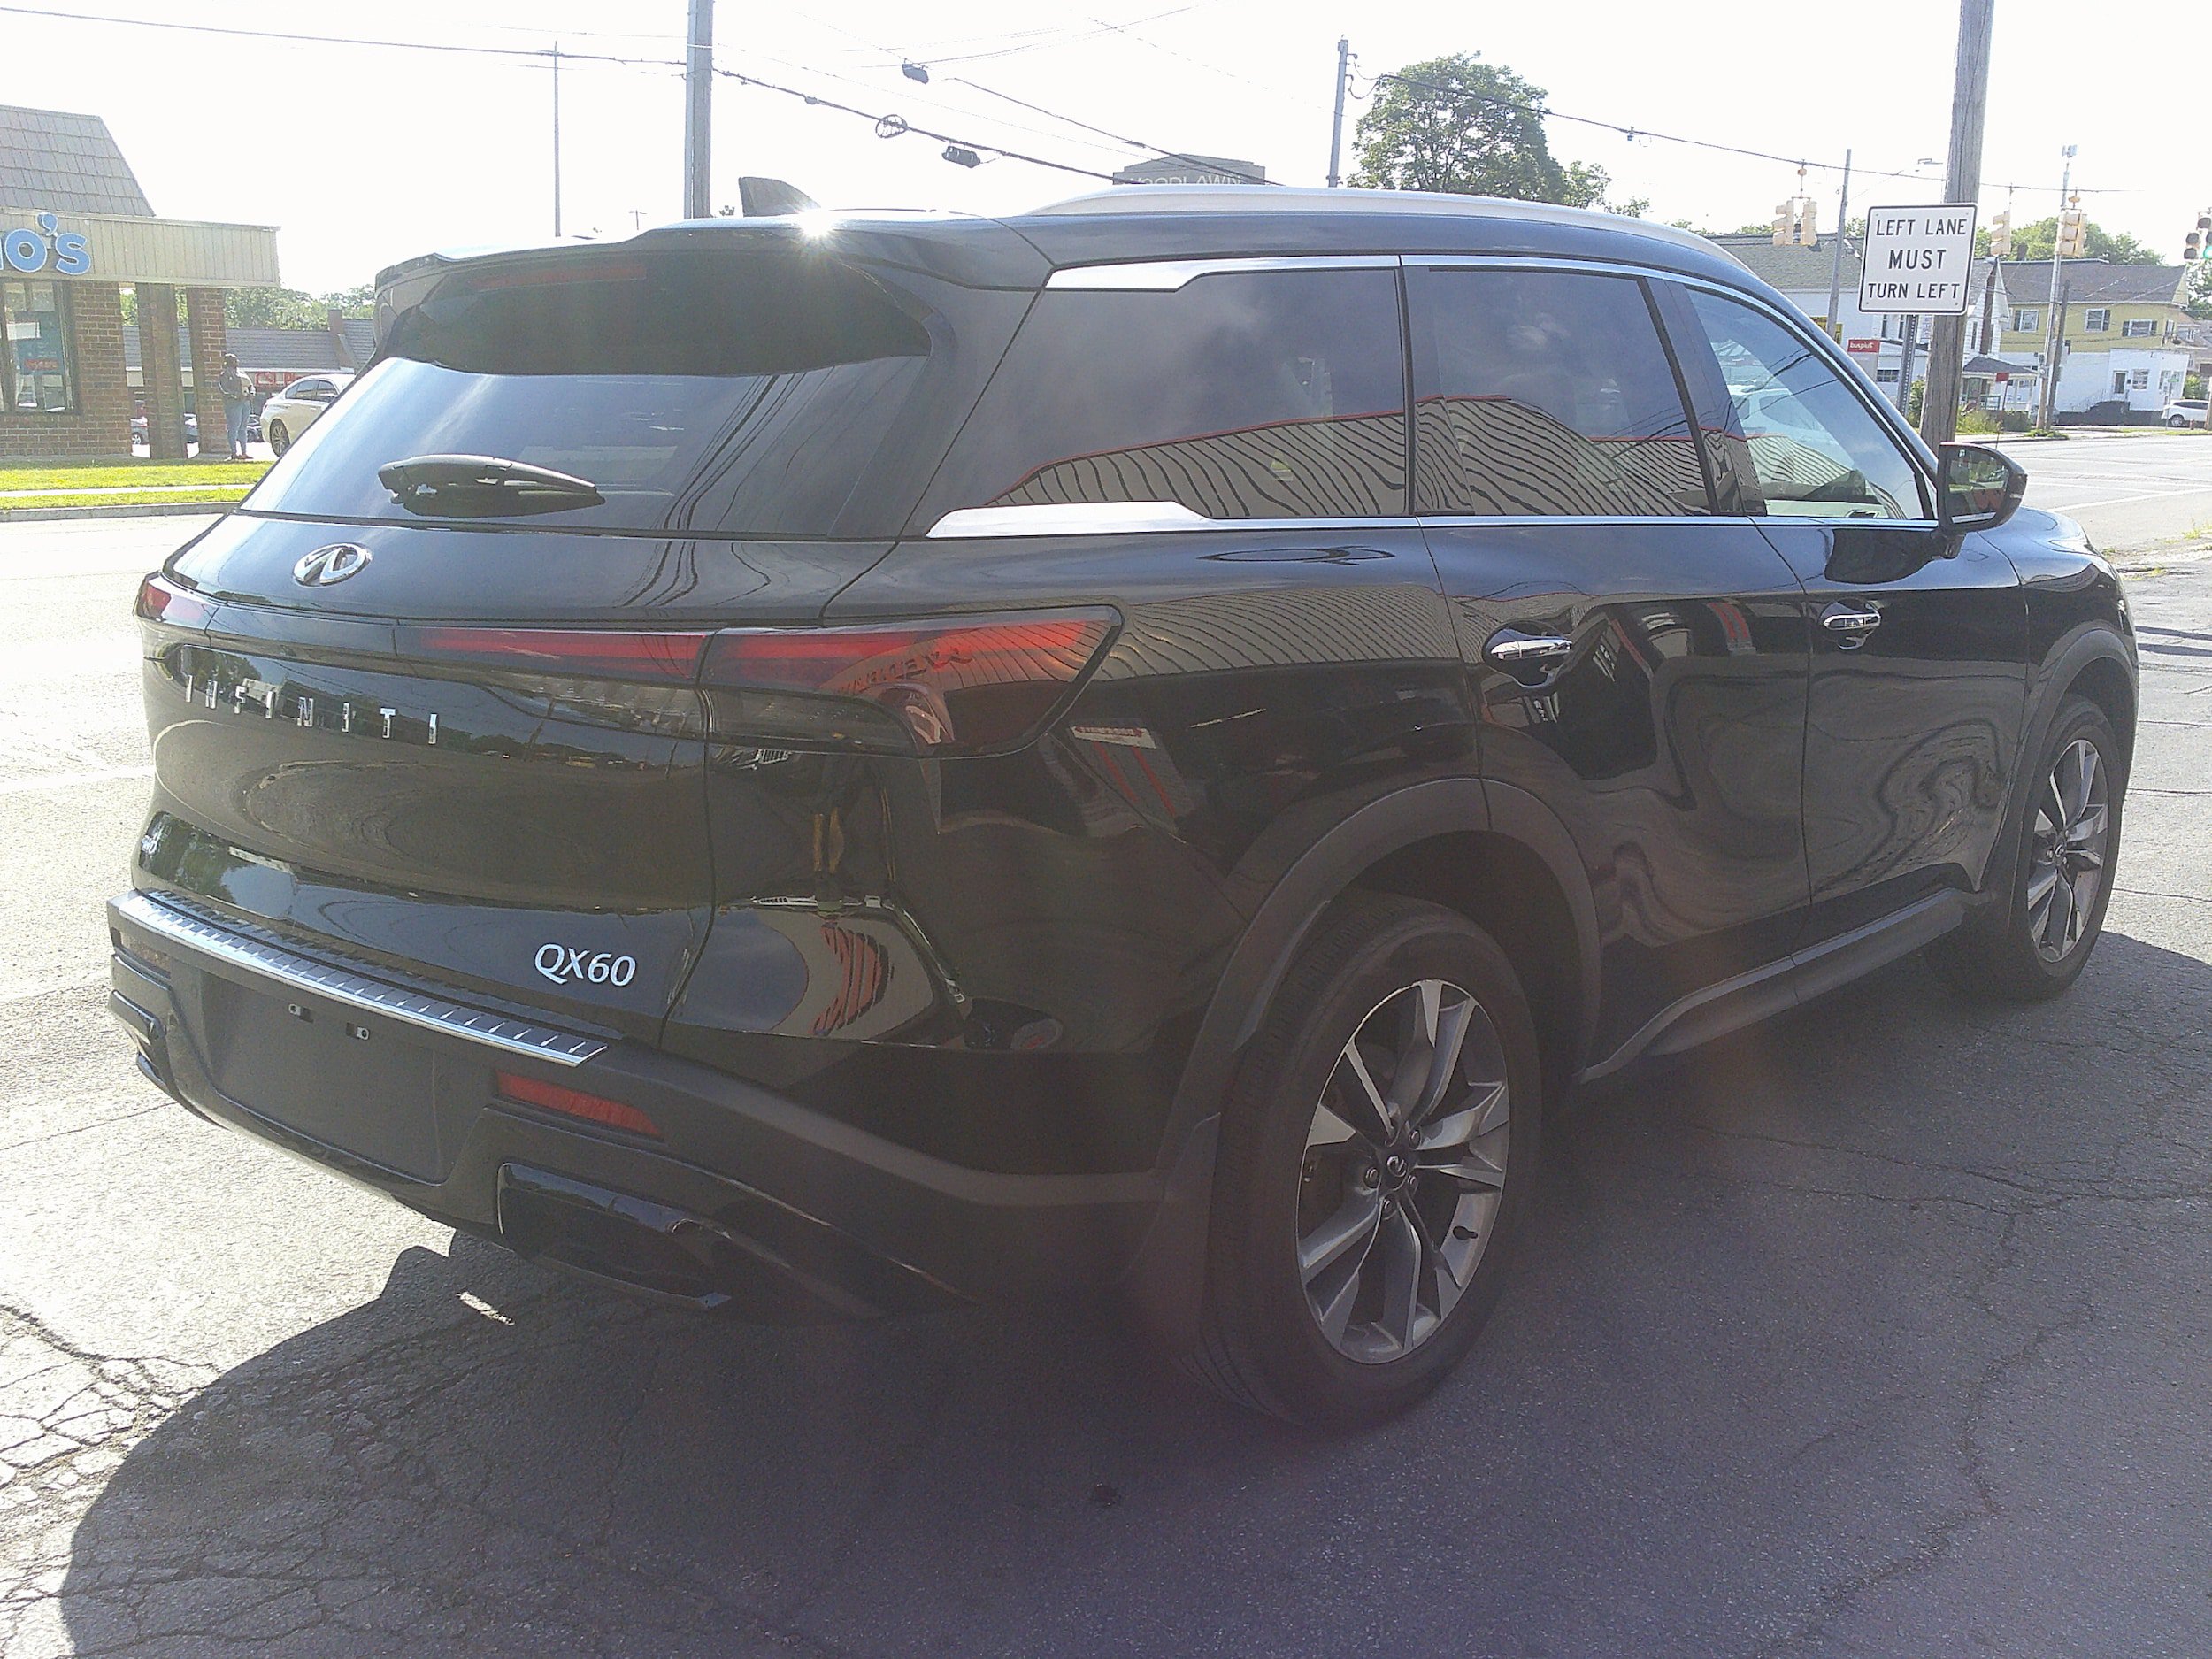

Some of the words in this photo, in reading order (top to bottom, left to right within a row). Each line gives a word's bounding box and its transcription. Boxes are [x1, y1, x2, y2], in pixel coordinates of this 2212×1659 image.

[0, 212, 91, 275] o's
[1876, 219, 1916, 236] LEFT
[1925, 219, 1967, 235] LANE
[1888, 249, 1947, 270] MUST
[1868, 282, 1909, 299] TURN
[1916, 282, 1961, 299] LEFT
[184, 674, 439, 745] INFINITI
[534, 942, 637, 987] QX60
